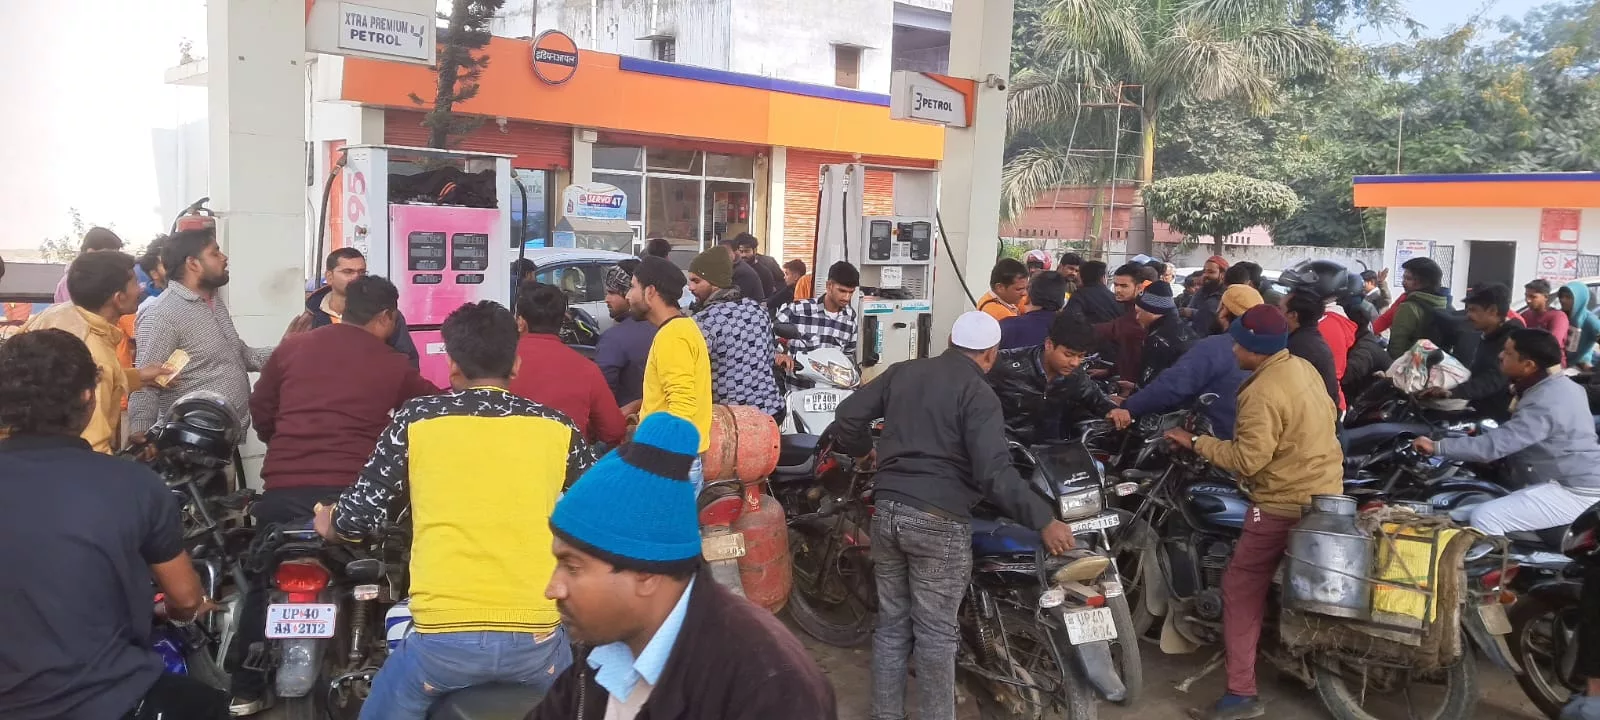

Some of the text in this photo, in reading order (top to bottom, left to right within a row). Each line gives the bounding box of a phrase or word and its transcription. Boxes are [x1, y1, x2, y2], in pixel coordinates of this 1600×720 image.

[345, 12, 408, 34] XTRA PREMIUM
[350, 28, 402, 46] PETROL
[915, 92, 922, 110] 3
[923, 97, 952, 112] PETROL
[588, 194, 623, 207] SERVO 4T
[282, 608, 319, 619] UP 40
[274, 623, 326, 634] AA 2112
